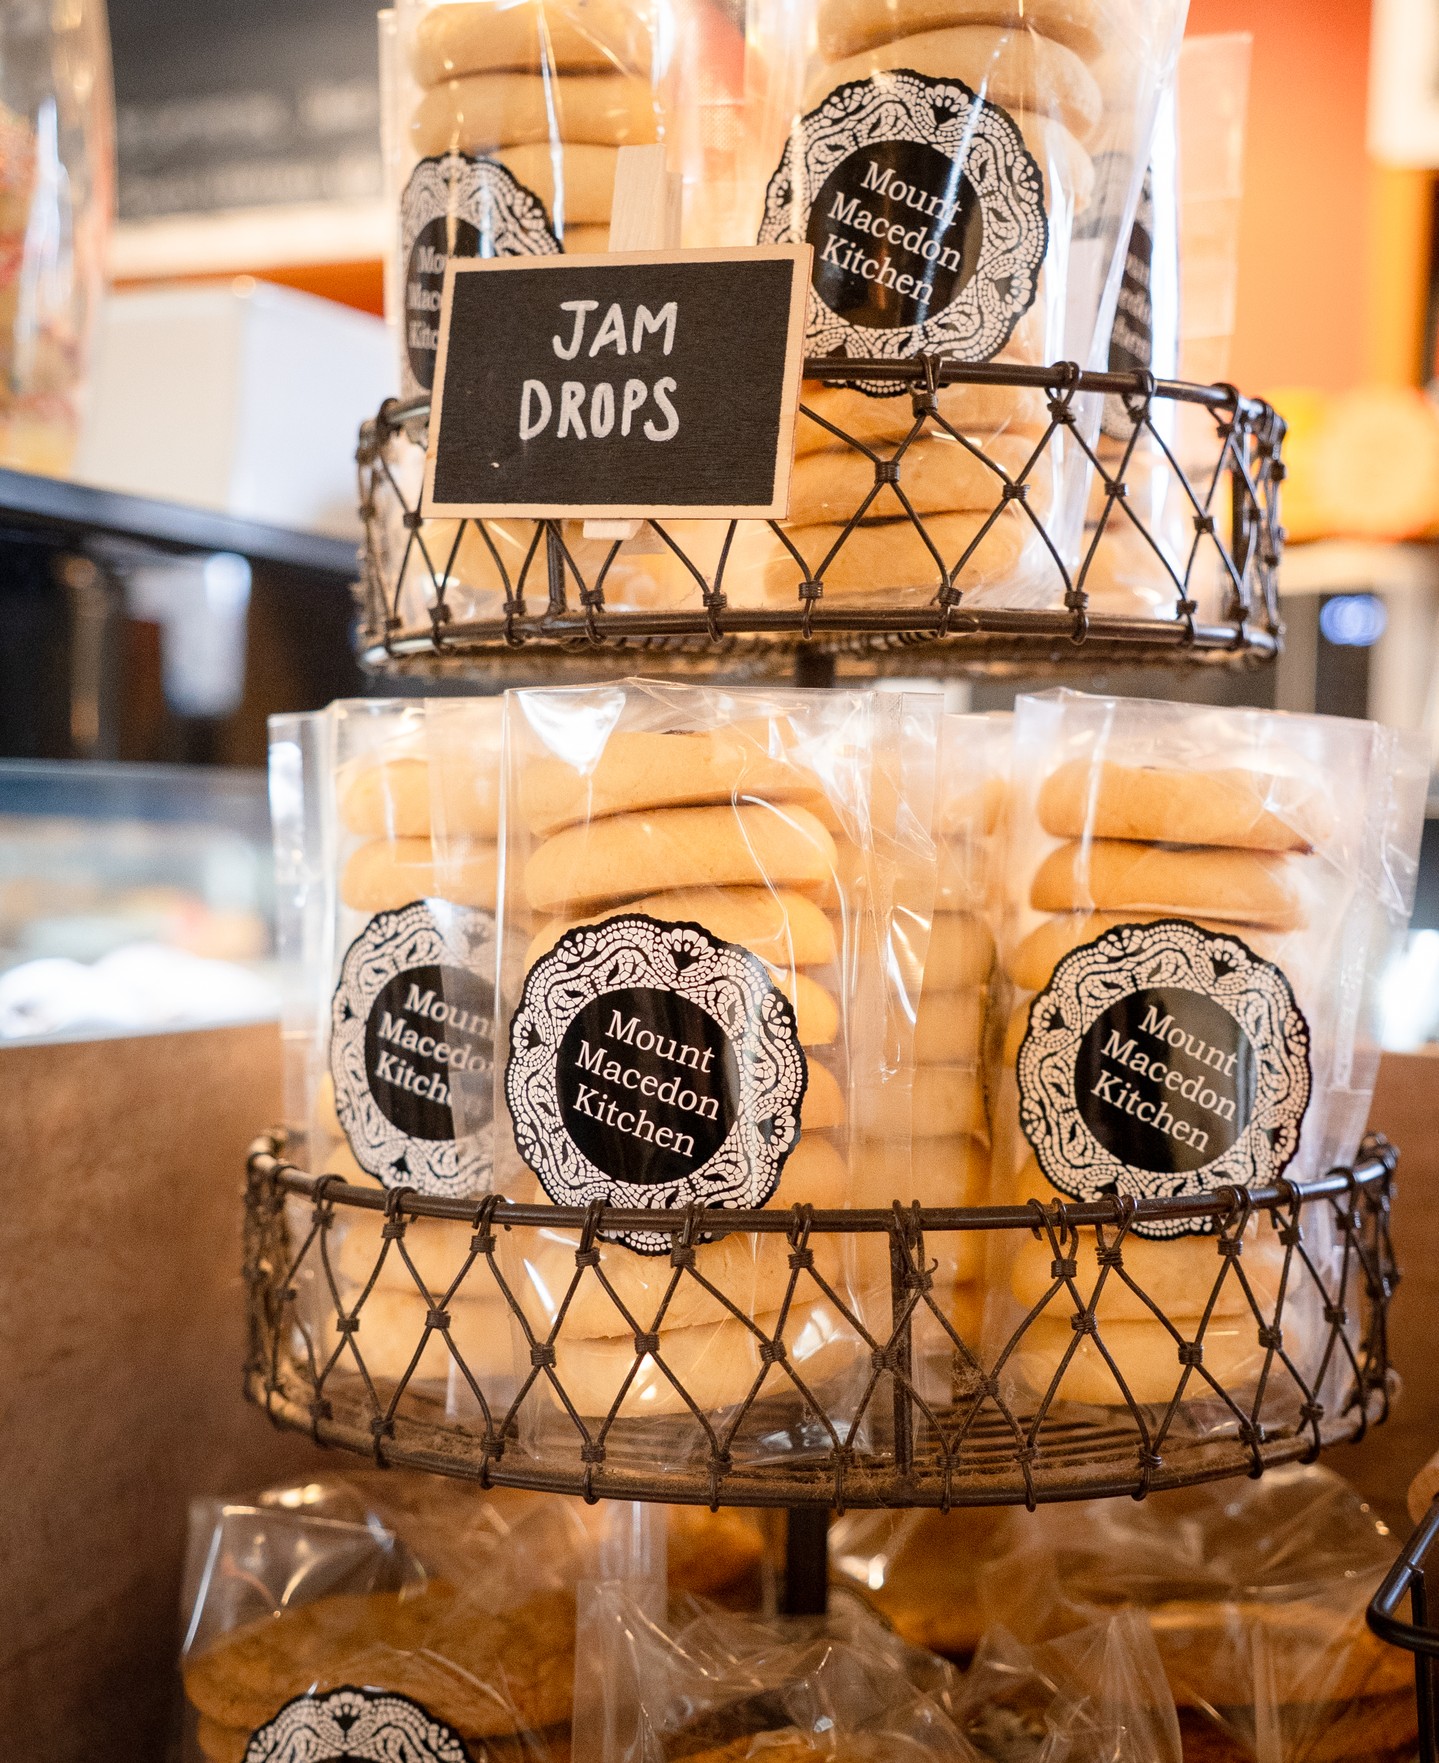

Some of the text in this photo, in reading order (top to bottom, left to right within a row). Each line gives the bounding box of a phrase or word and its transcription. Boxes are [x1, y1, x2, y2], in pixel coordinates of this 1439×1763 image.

[860, 161, 963, 227] Mount
[826, 192, 964, 273] Macedon
[819, 234, 934, 306] Kitchen
[552, 300, 678, 361] JAM
[519, 376, 680, 442] DROPS
[605, 1009, 715, 1074] Mount
[1100, 1030, 1237, 1122] Macedon
[1138, 1005, 1239, 1078] Mount
[574, 1040, 721, 1121] Macedon
[1090, 1069, 1211, 1154] Kitchen
[572, 1083, 697, 1158] Kitchen
